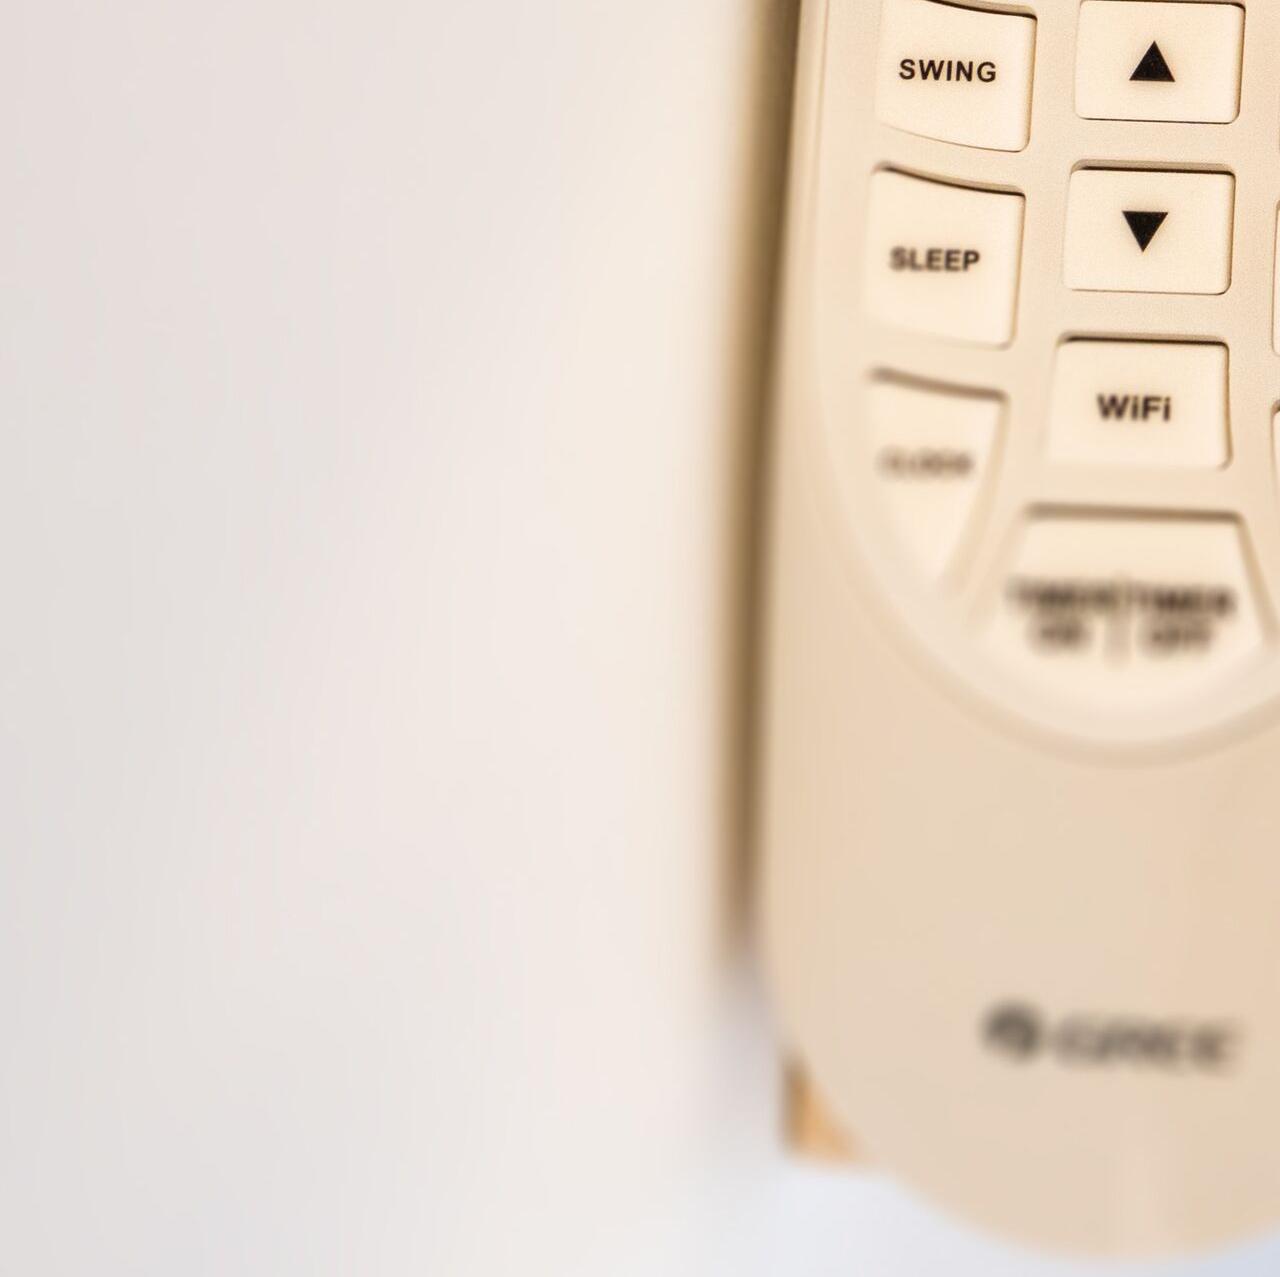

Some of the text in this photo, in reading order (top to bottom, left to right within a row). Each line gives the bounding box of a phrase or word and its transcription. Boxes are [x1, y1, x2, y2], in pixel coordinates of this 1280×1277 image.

[897, 57, 998, 85] SWING
[889, 246, 981, 274] SLEEP
[1095, 393, 1173, 423] WiFi
